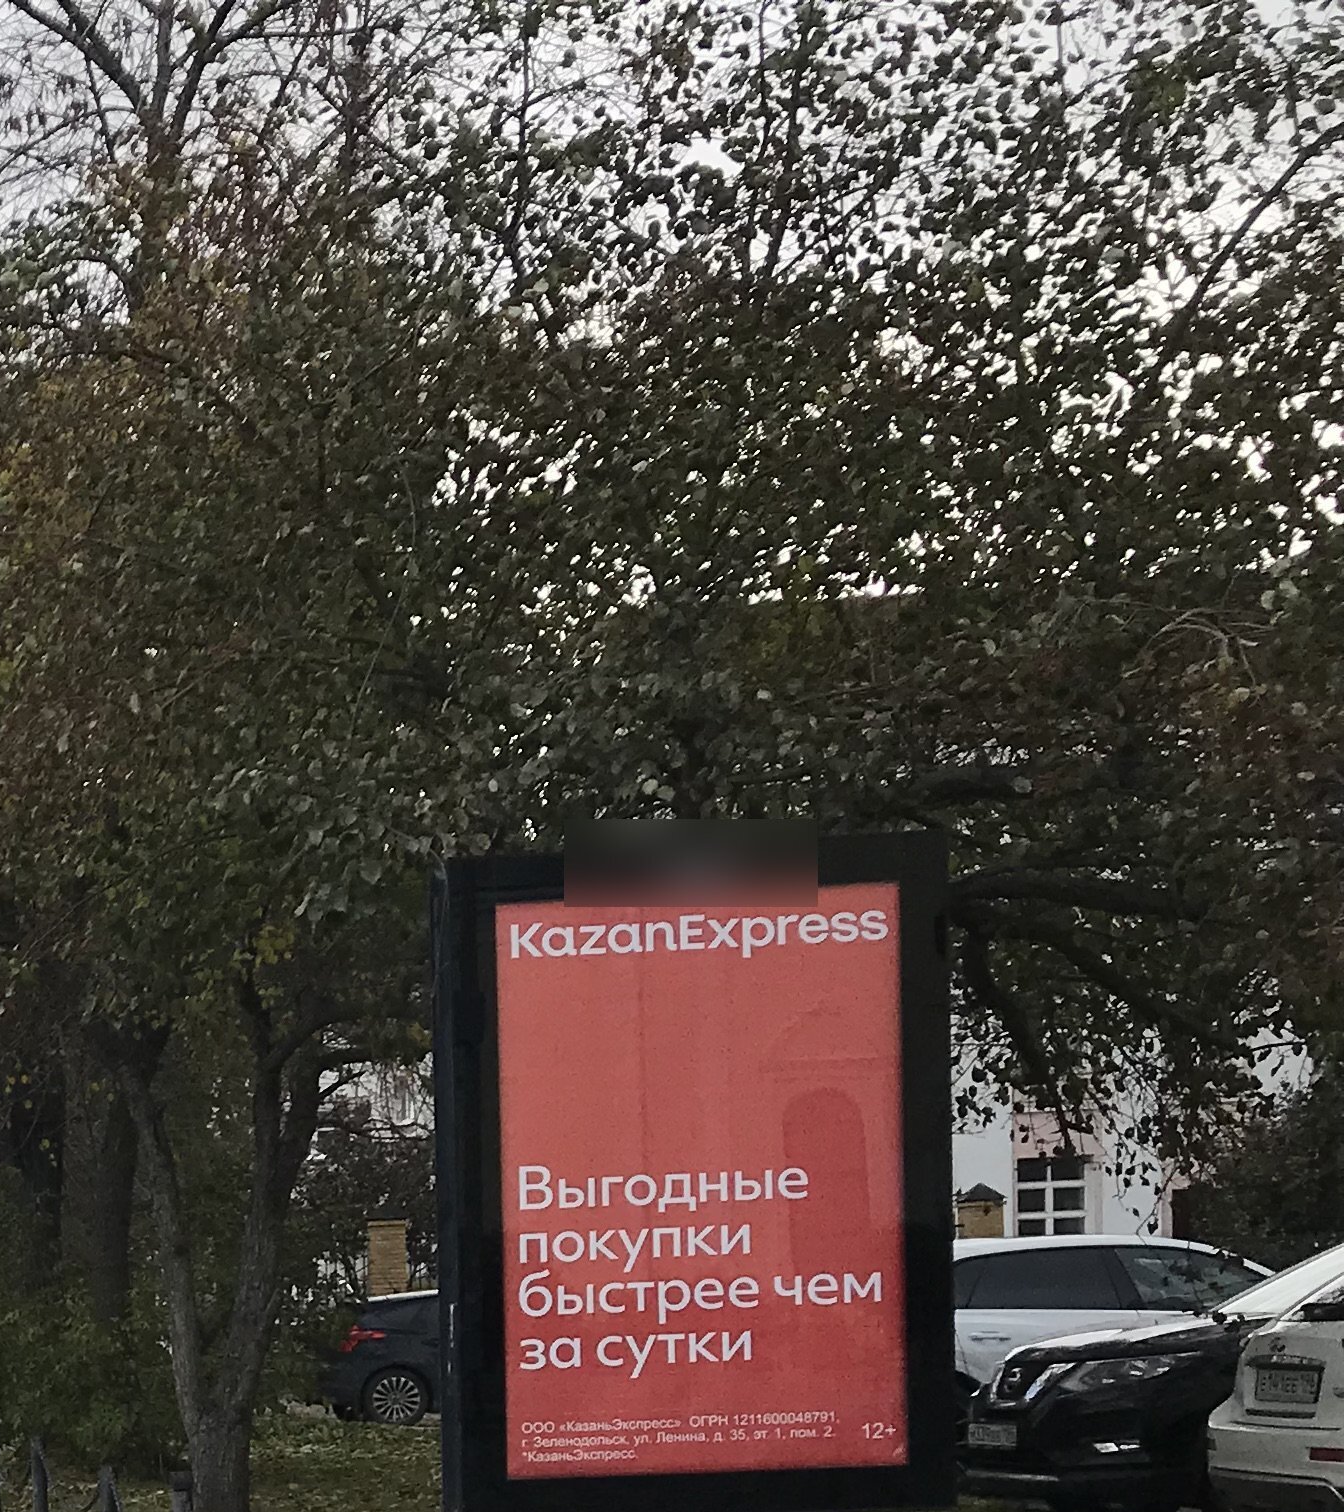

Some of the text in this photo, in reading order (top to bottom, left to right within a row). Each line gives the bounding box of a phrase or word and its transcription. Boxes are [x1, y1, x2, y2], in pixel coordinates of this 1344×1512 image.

[510, 908, 889, 959] KazanExpress
[518, 1164, 810, 1213] Выгодные
[518, 1223, 752, 1273] покупки
[518, 1269, 883, 1324] быстрее чем
[518, 1329, 754, 1379] за сутки
[521, 1421, 555, 1434] ООО
[689, 1414, 728, 1428] ОГРН
[655, 1431, 710, 1443] Ленина,
[861, 1422, 896, 1439] 12+
